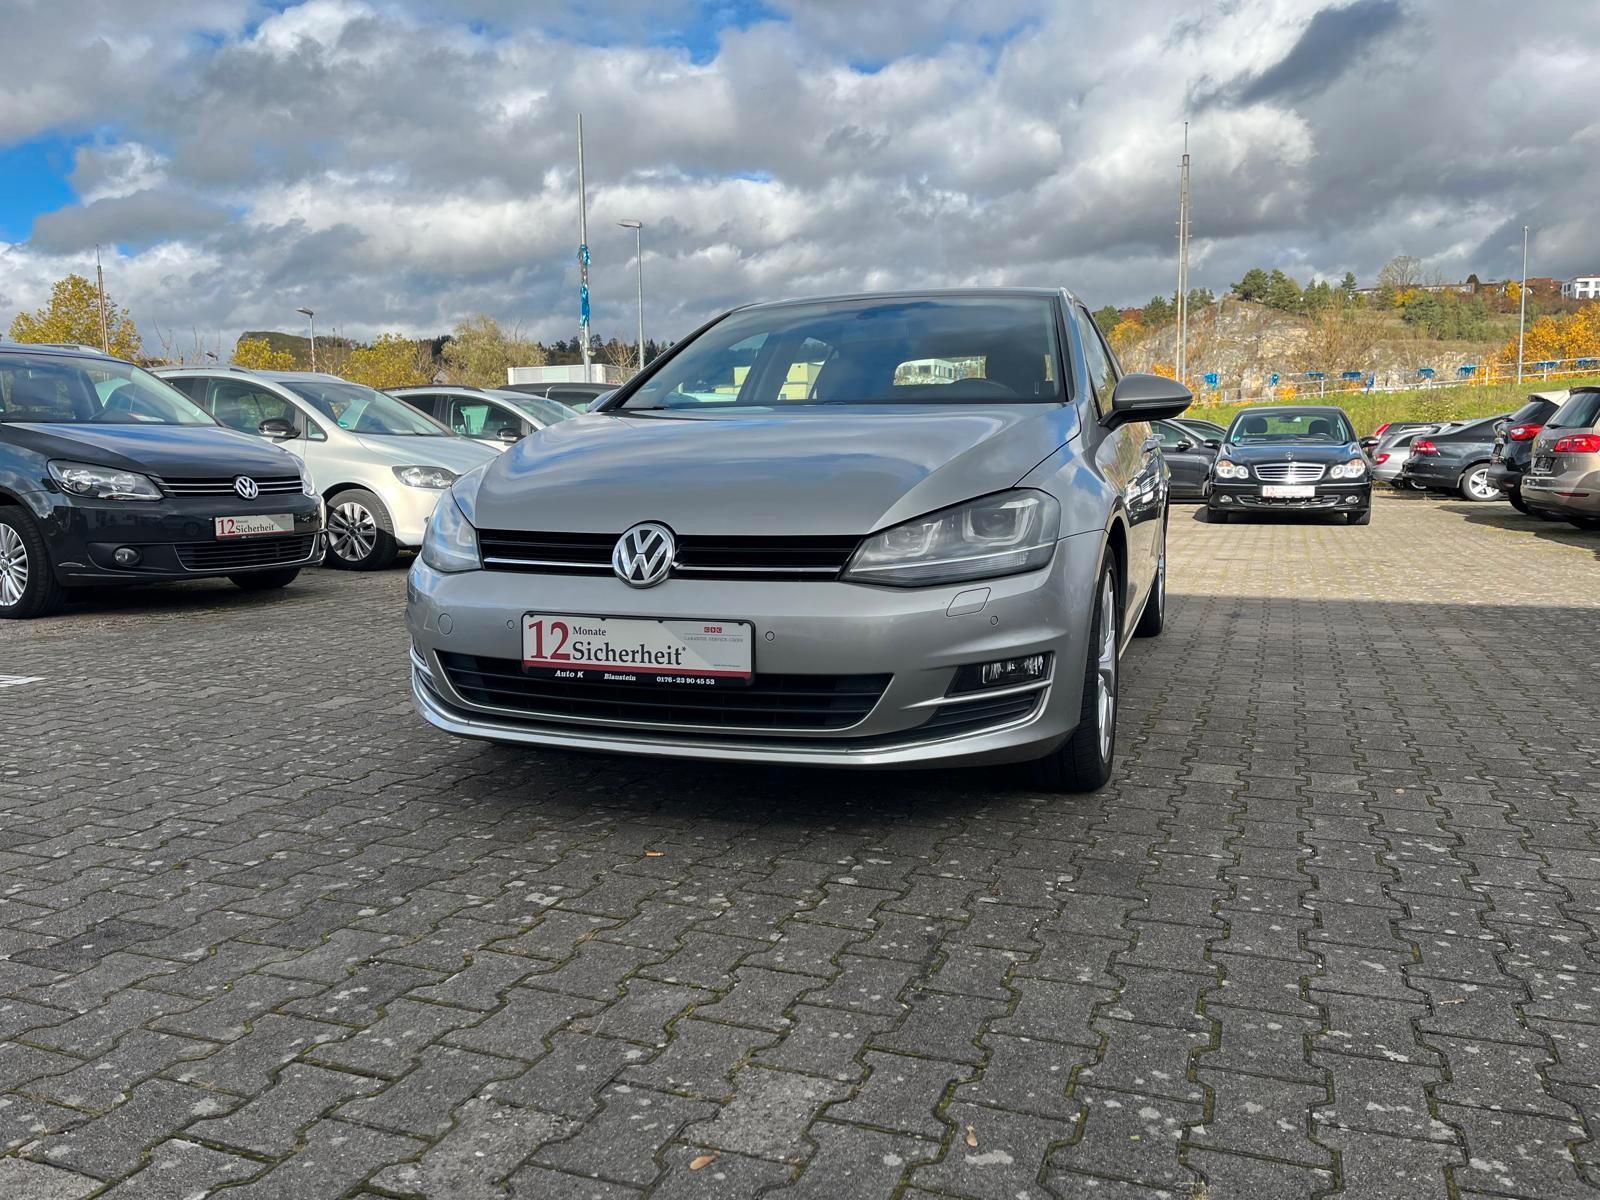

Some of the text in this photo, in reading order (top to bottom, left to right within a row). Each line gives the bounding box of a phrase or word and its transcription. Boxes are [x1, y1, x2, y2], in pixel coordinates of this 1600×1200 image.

[218, 519, 236, 535] 12
[235, 524, 274, 534] Sicherheit
[572, 626, 607, 636] Monate
[528, 620, 571, 661] 12
[555, 670, 575, 678] Auto
[604, 673, 636, 681] Blaustein
